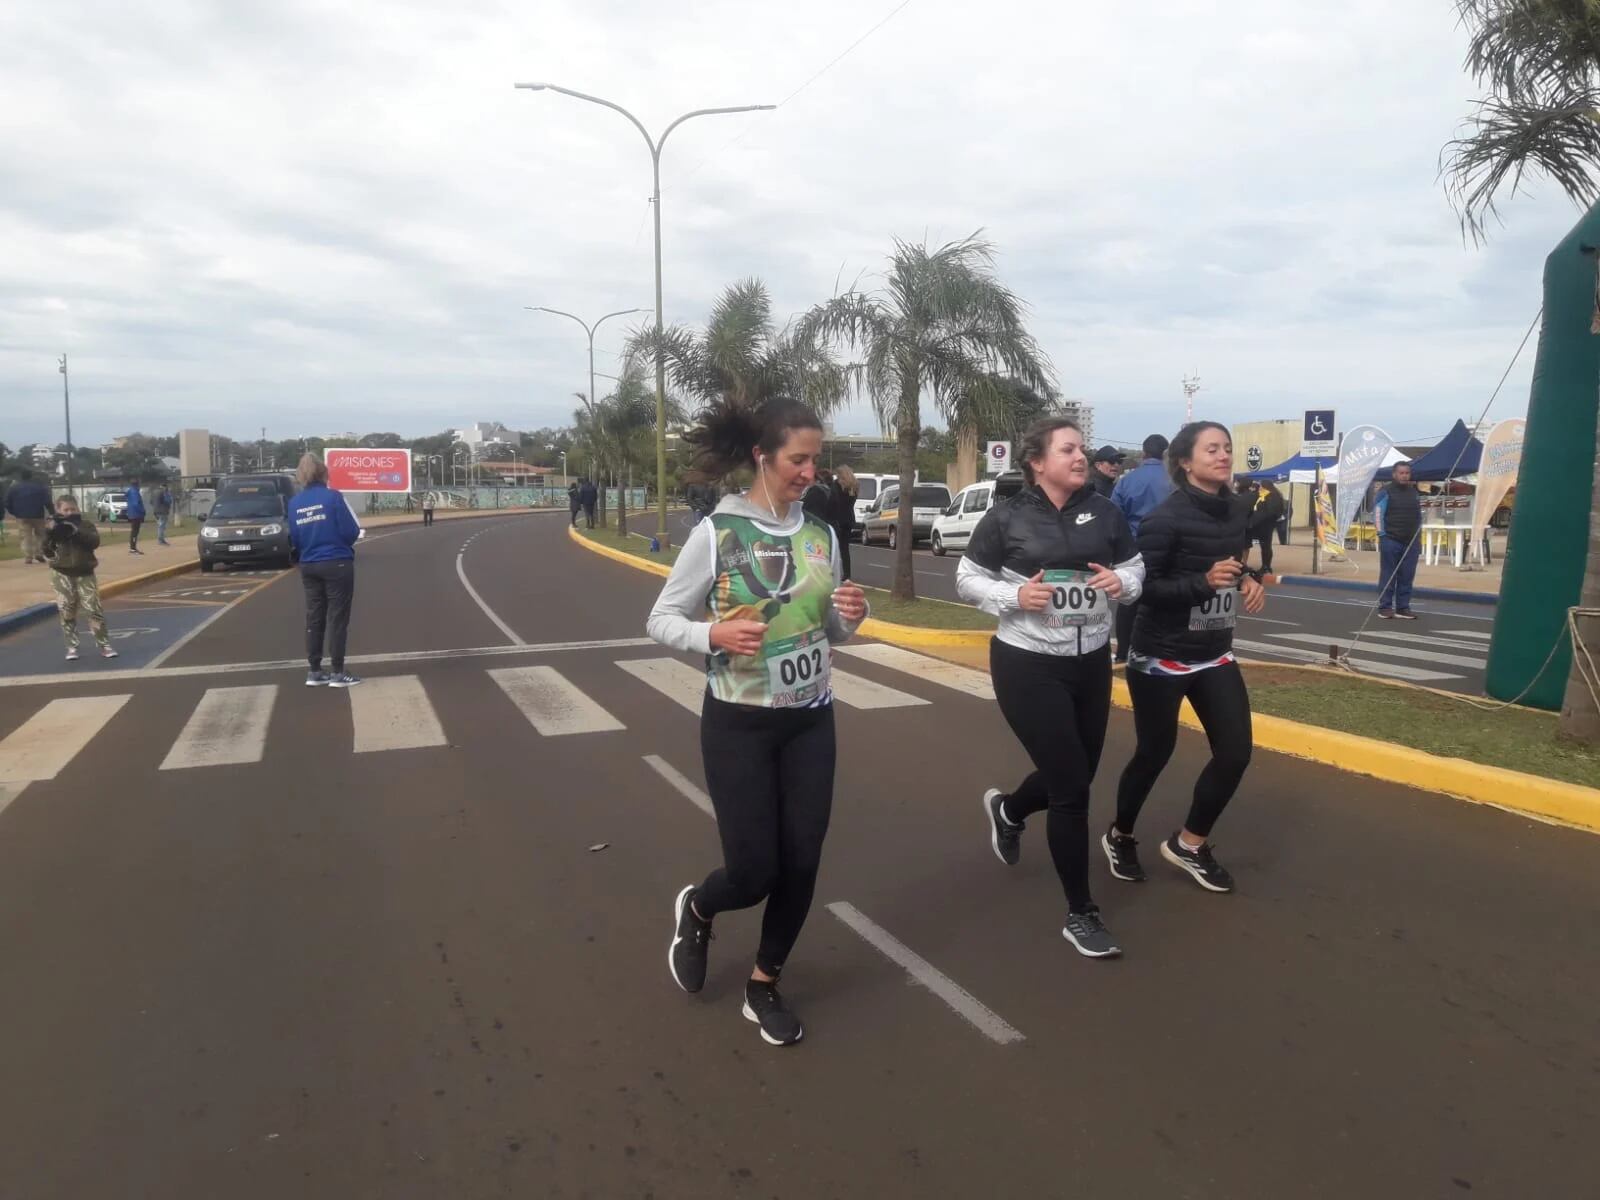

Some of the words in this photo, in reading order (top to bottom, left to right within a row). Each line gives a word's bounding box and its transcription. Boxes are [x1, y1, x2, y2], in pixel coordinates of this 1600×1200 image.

[996, 448, 1002, 456] E
[333, 456, 395, 468] MISIONES
[754, 549, 788, 558] Misiones
[1052, 586, 1098, 609] 009
[780, 647, 823, 686] 002
